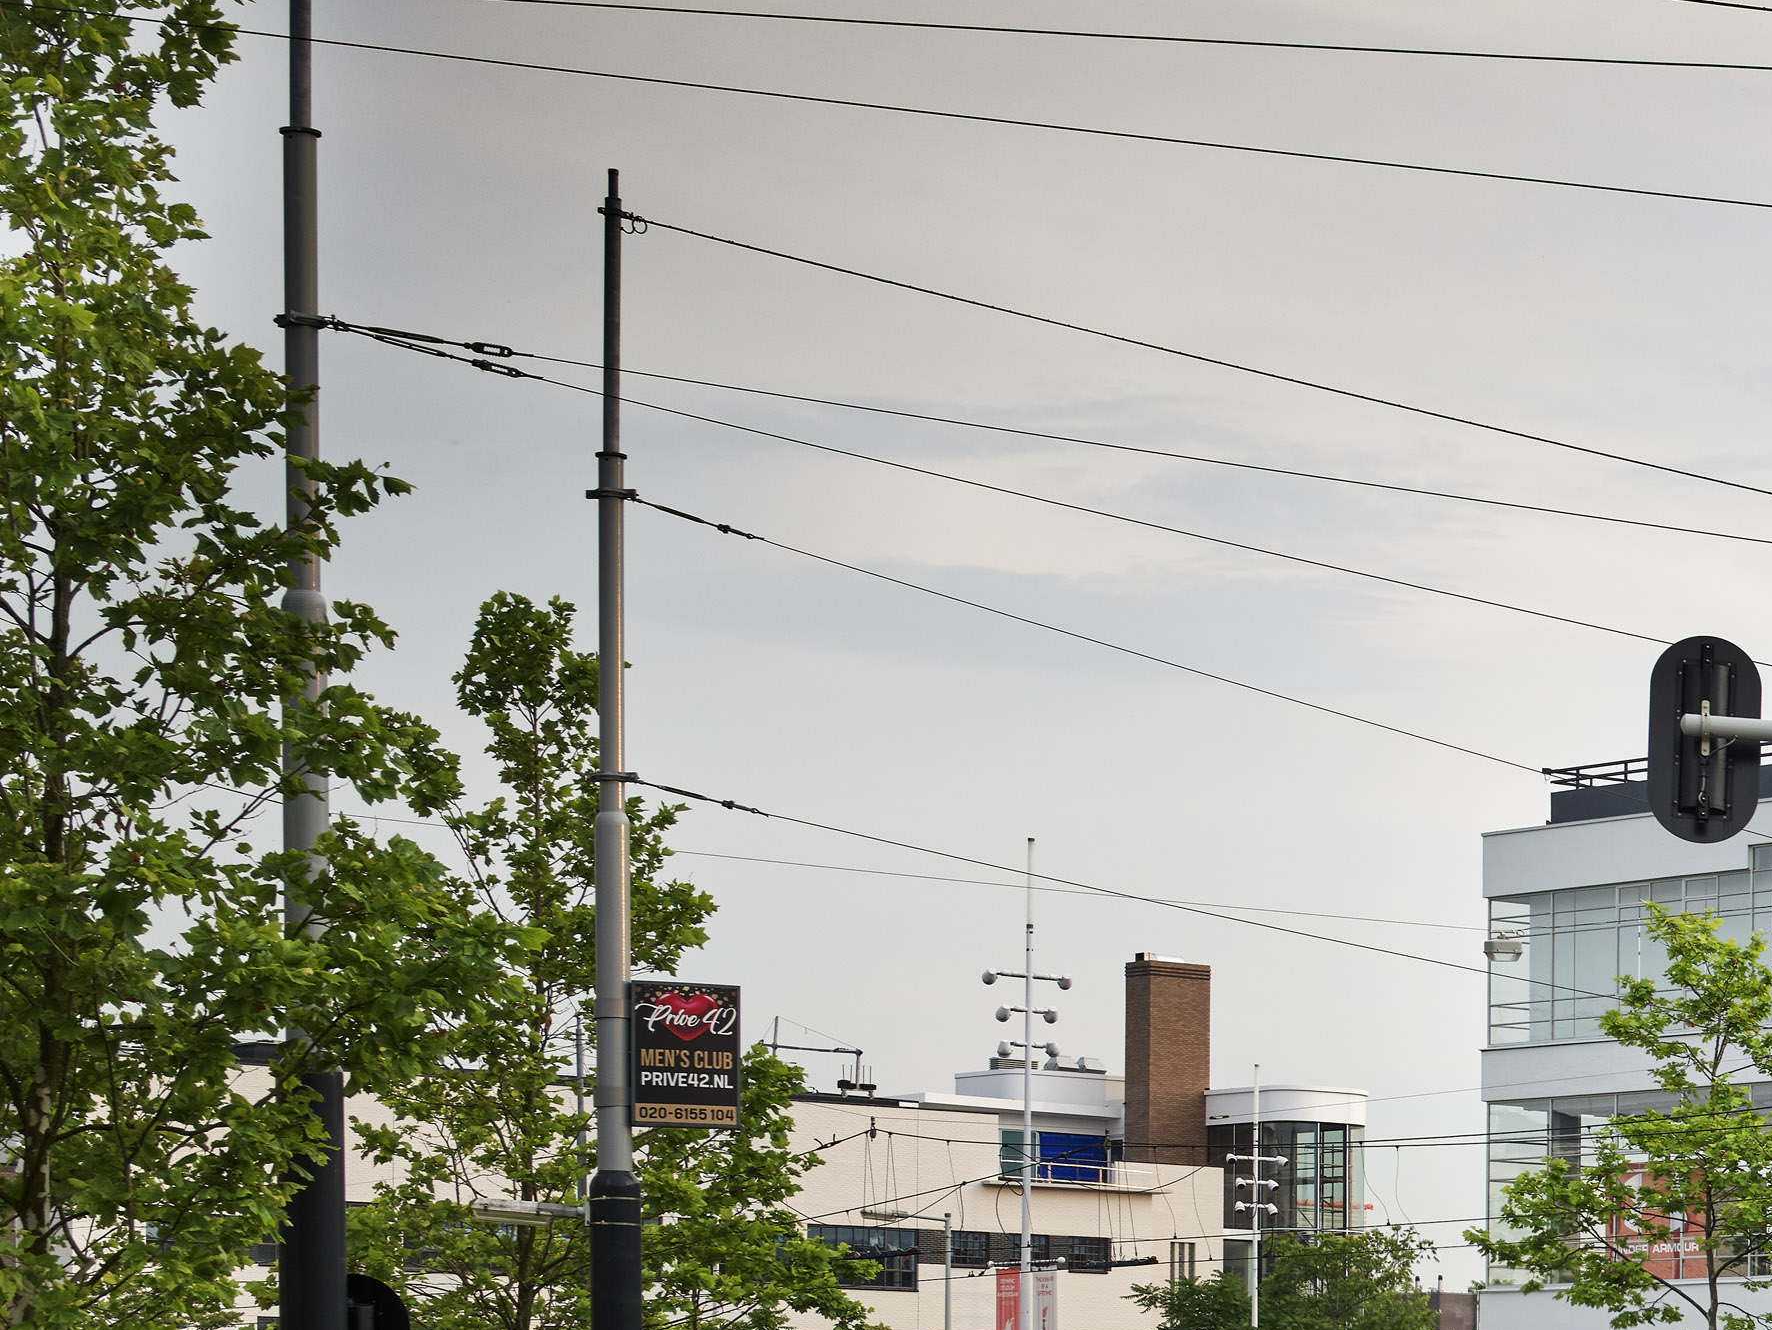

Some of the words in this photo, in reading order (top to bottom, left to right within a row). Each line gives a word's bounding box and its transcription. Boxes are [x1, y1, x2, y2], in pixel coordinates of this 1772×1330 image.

[634, 1003, 700, 1032] Prive
[702, 1007, 737, 1035] 42
[640, 1048, 690, 1068] MEN'S
[693, 1051, 733, 1070] CLUB
[641, 1071, 734, 1089] PRIVE42.NL
[1616, 1244, 1648, 1254] NDER
